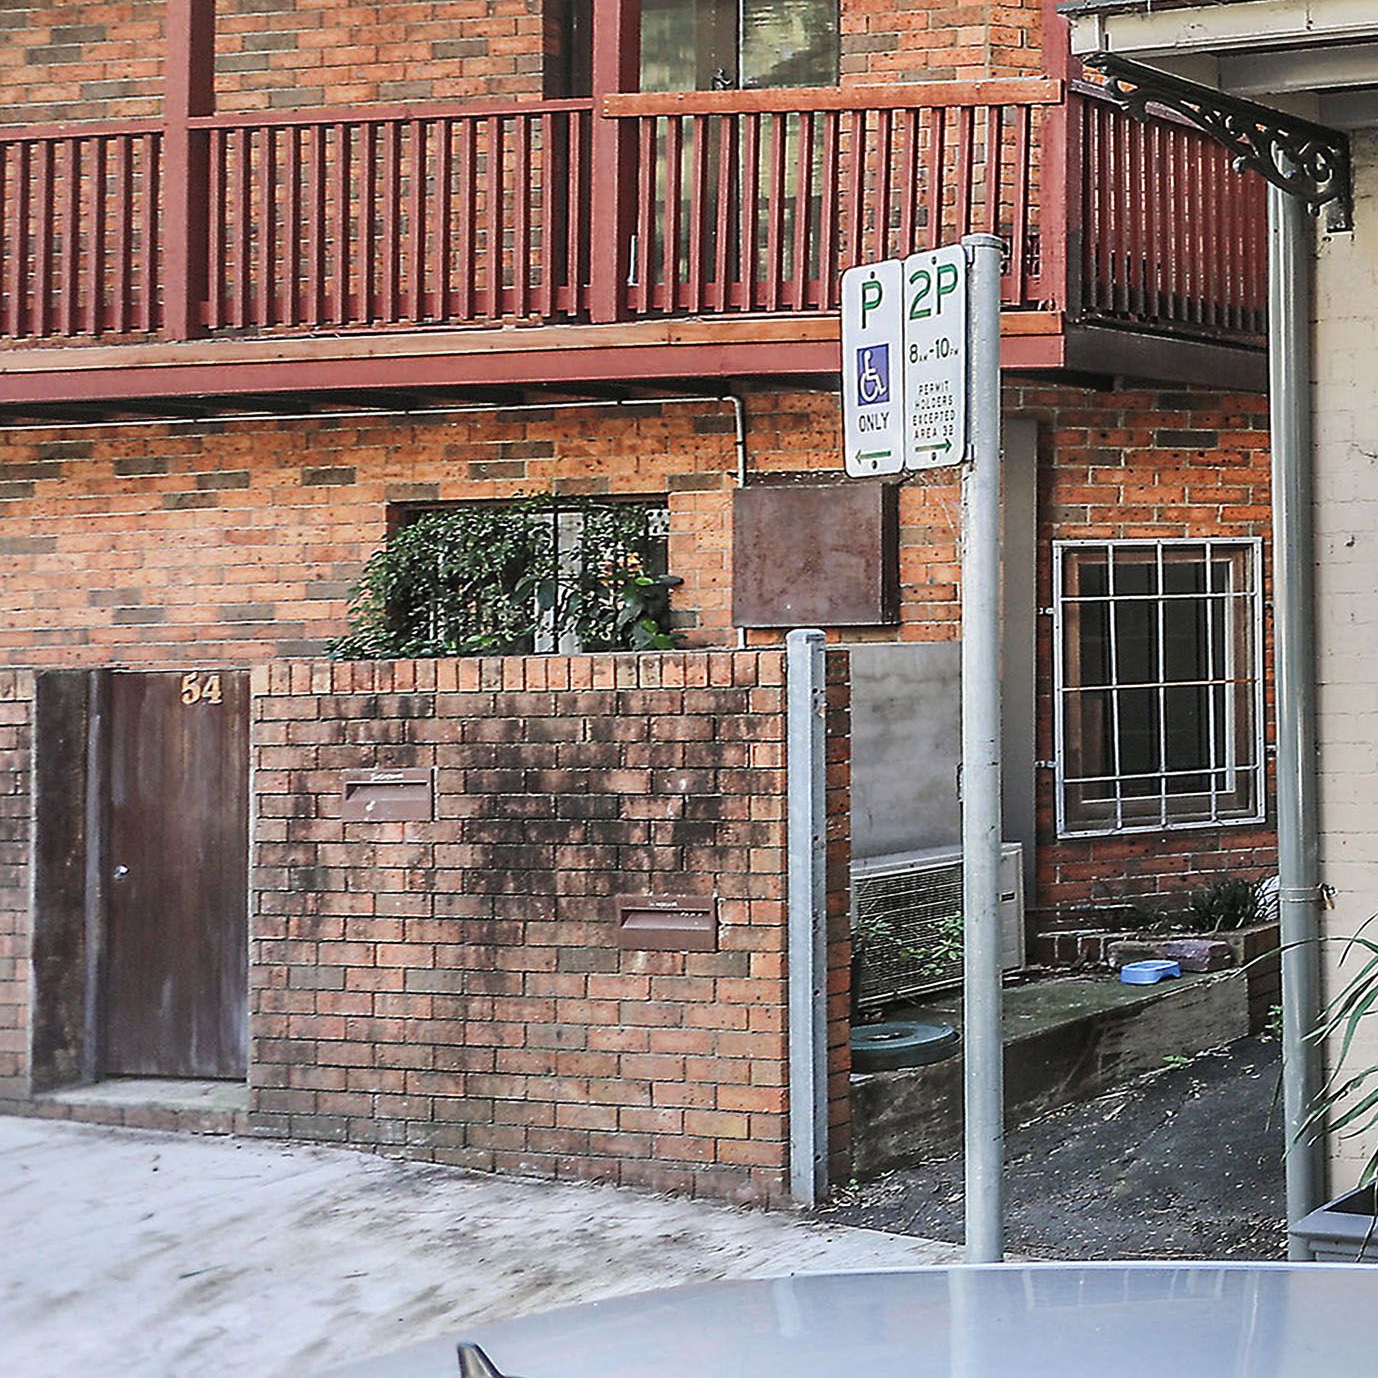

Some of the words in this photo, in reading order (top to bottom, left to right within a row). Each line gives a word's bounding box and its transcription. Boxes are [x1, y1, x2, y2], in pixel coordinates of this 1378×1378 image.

[909, 263, 958, 321] 2P
[861, 280, 883, 330] P
[918, 380, 949, 396] PERMIT
[915, 394, 953, 410] HOLDERS
[858, 411, 890, 433] ONLY
[912, 409, 955, 426] EXCEPTED
[914, 426, 936, 440] AREA
[180, 671, 222, 705] 54
